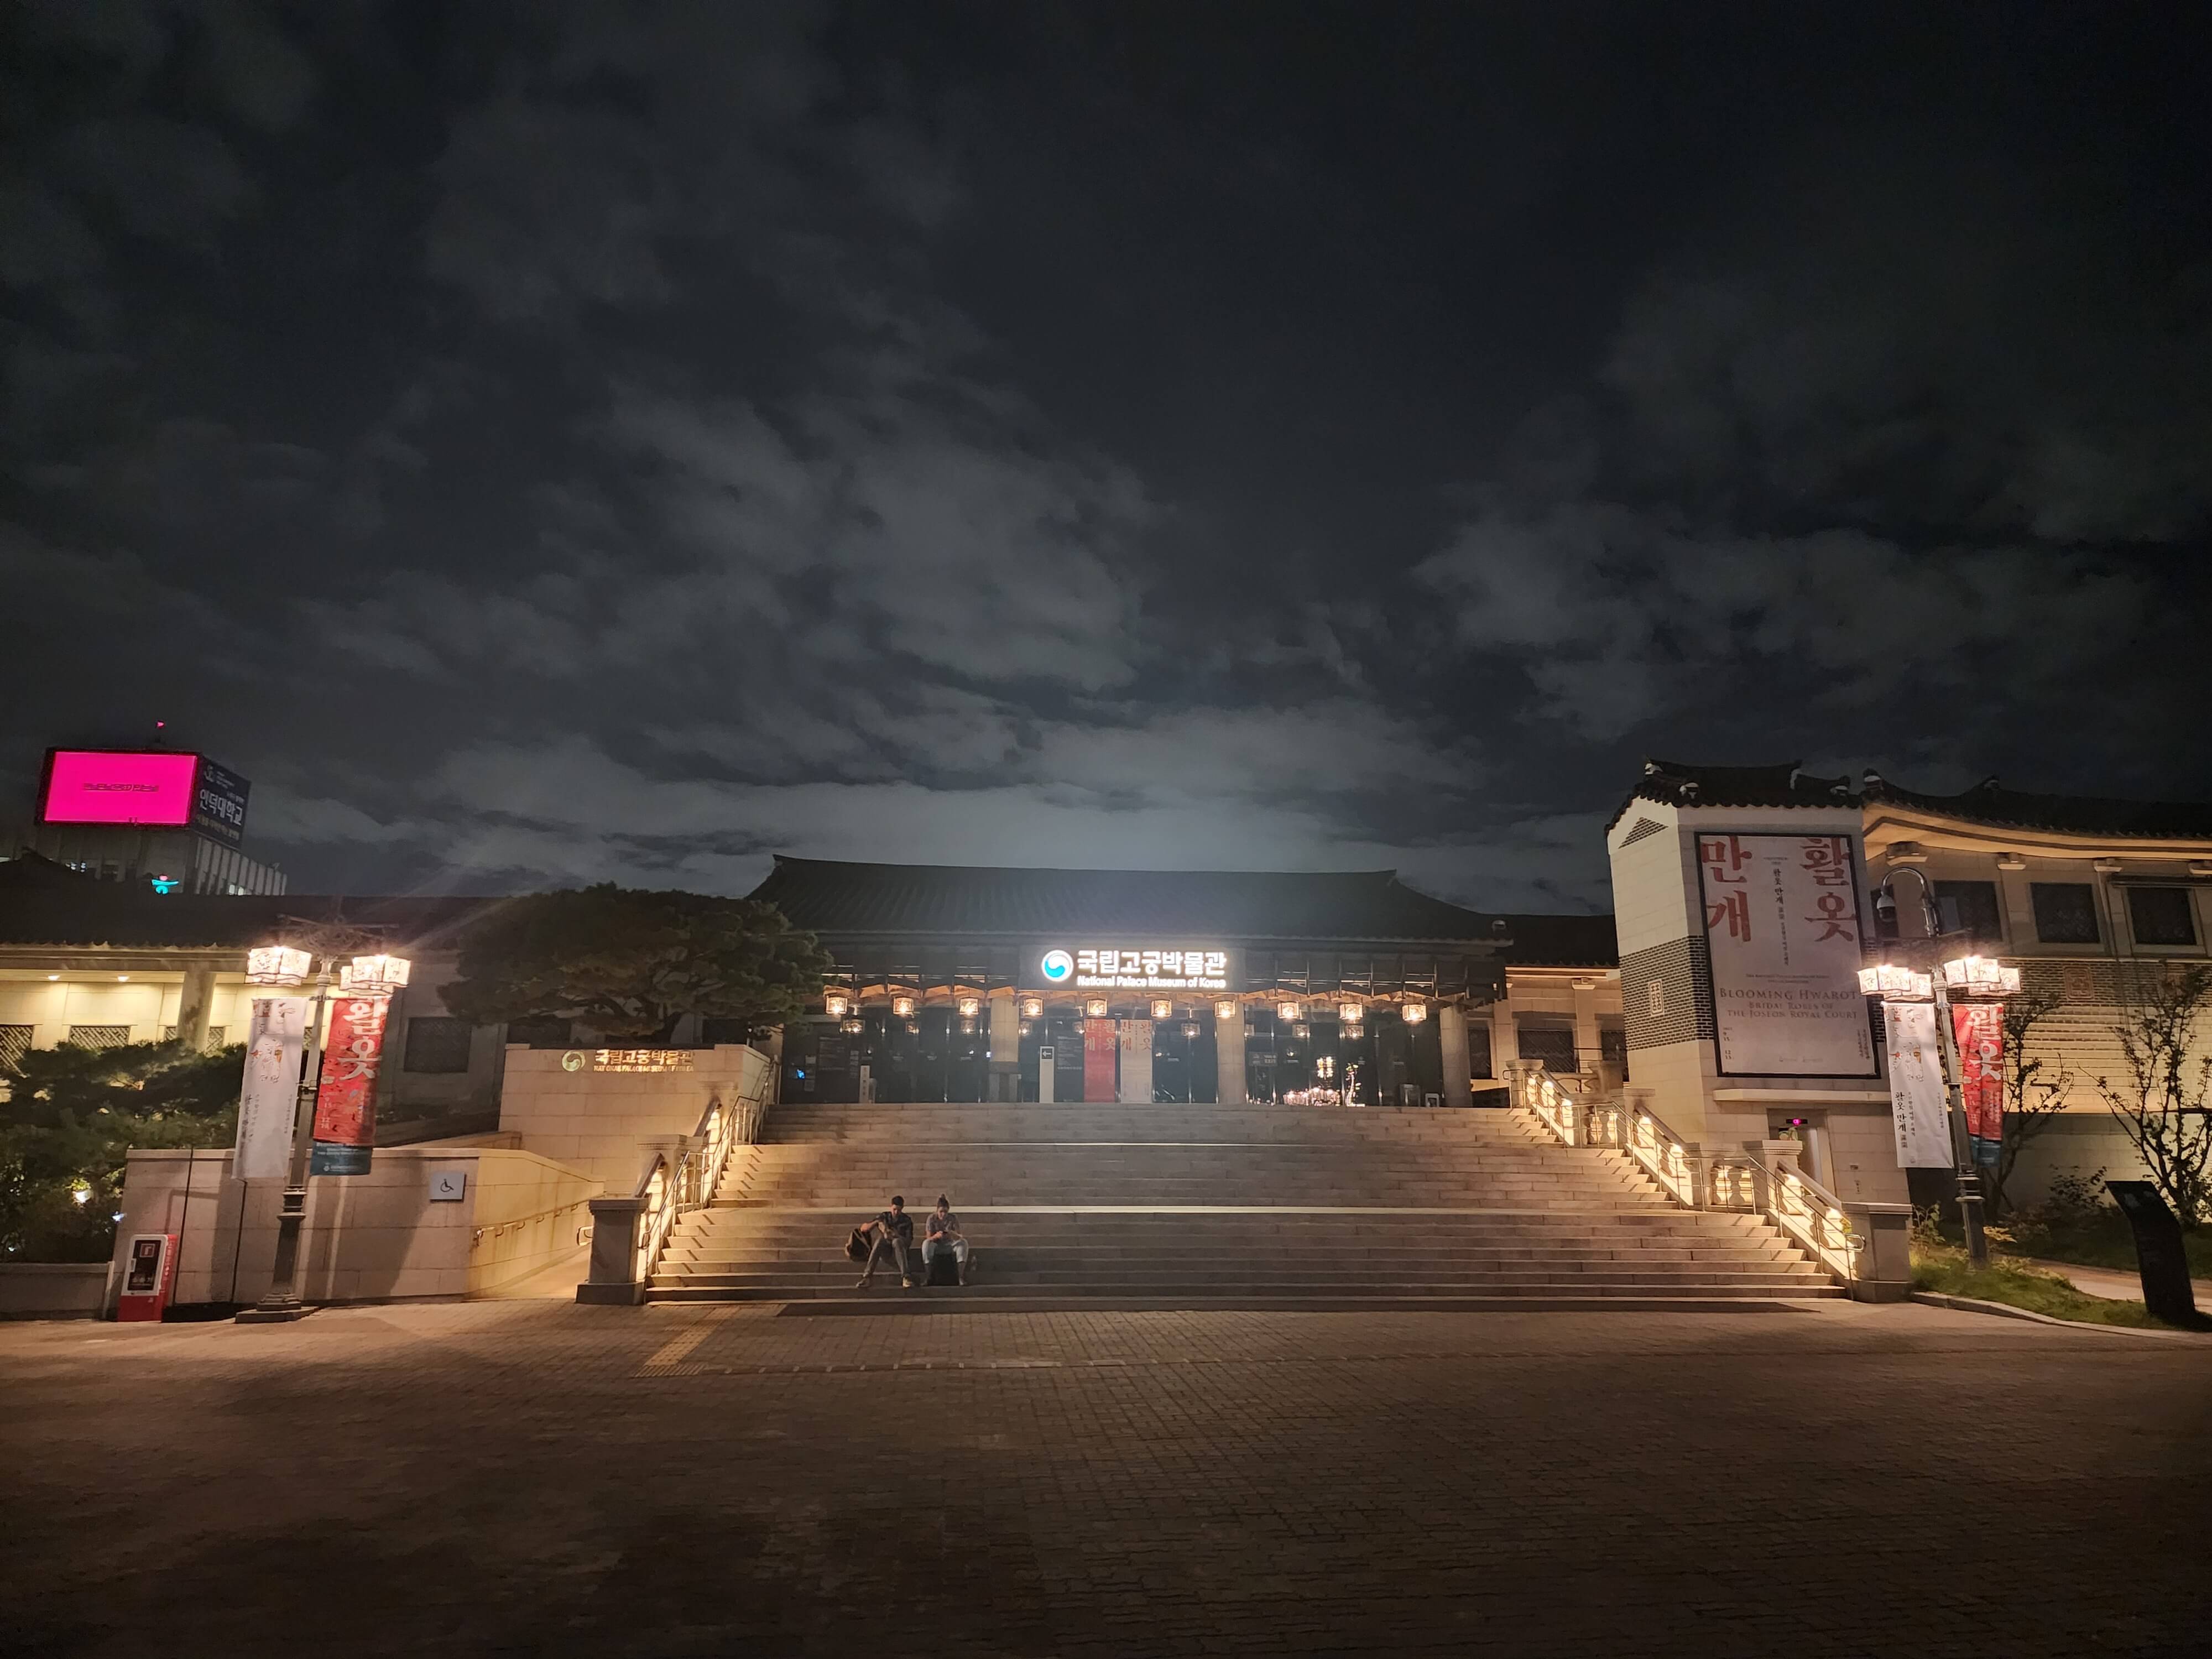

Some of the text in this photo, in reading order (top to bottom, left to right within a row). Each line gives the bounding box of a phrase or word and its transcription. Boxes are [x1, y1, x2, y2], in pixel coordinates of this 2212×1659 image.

[200, 789, 243, 826] 인덕대학교
[1700, 836, 1752, 942] 만개
[1799, 838, 1858, 942] 활옷
[1077, 950, 1227, 975] 국립고궁박물관
[1077, 975, 1226, 988] National Palace Museum of Korea
[595, 1049, 695, 1065] 국립고궁박물관
[1895, 1092, 1906, 1111] 활옷
[1896, 1114, 1907, 1132] 만개
